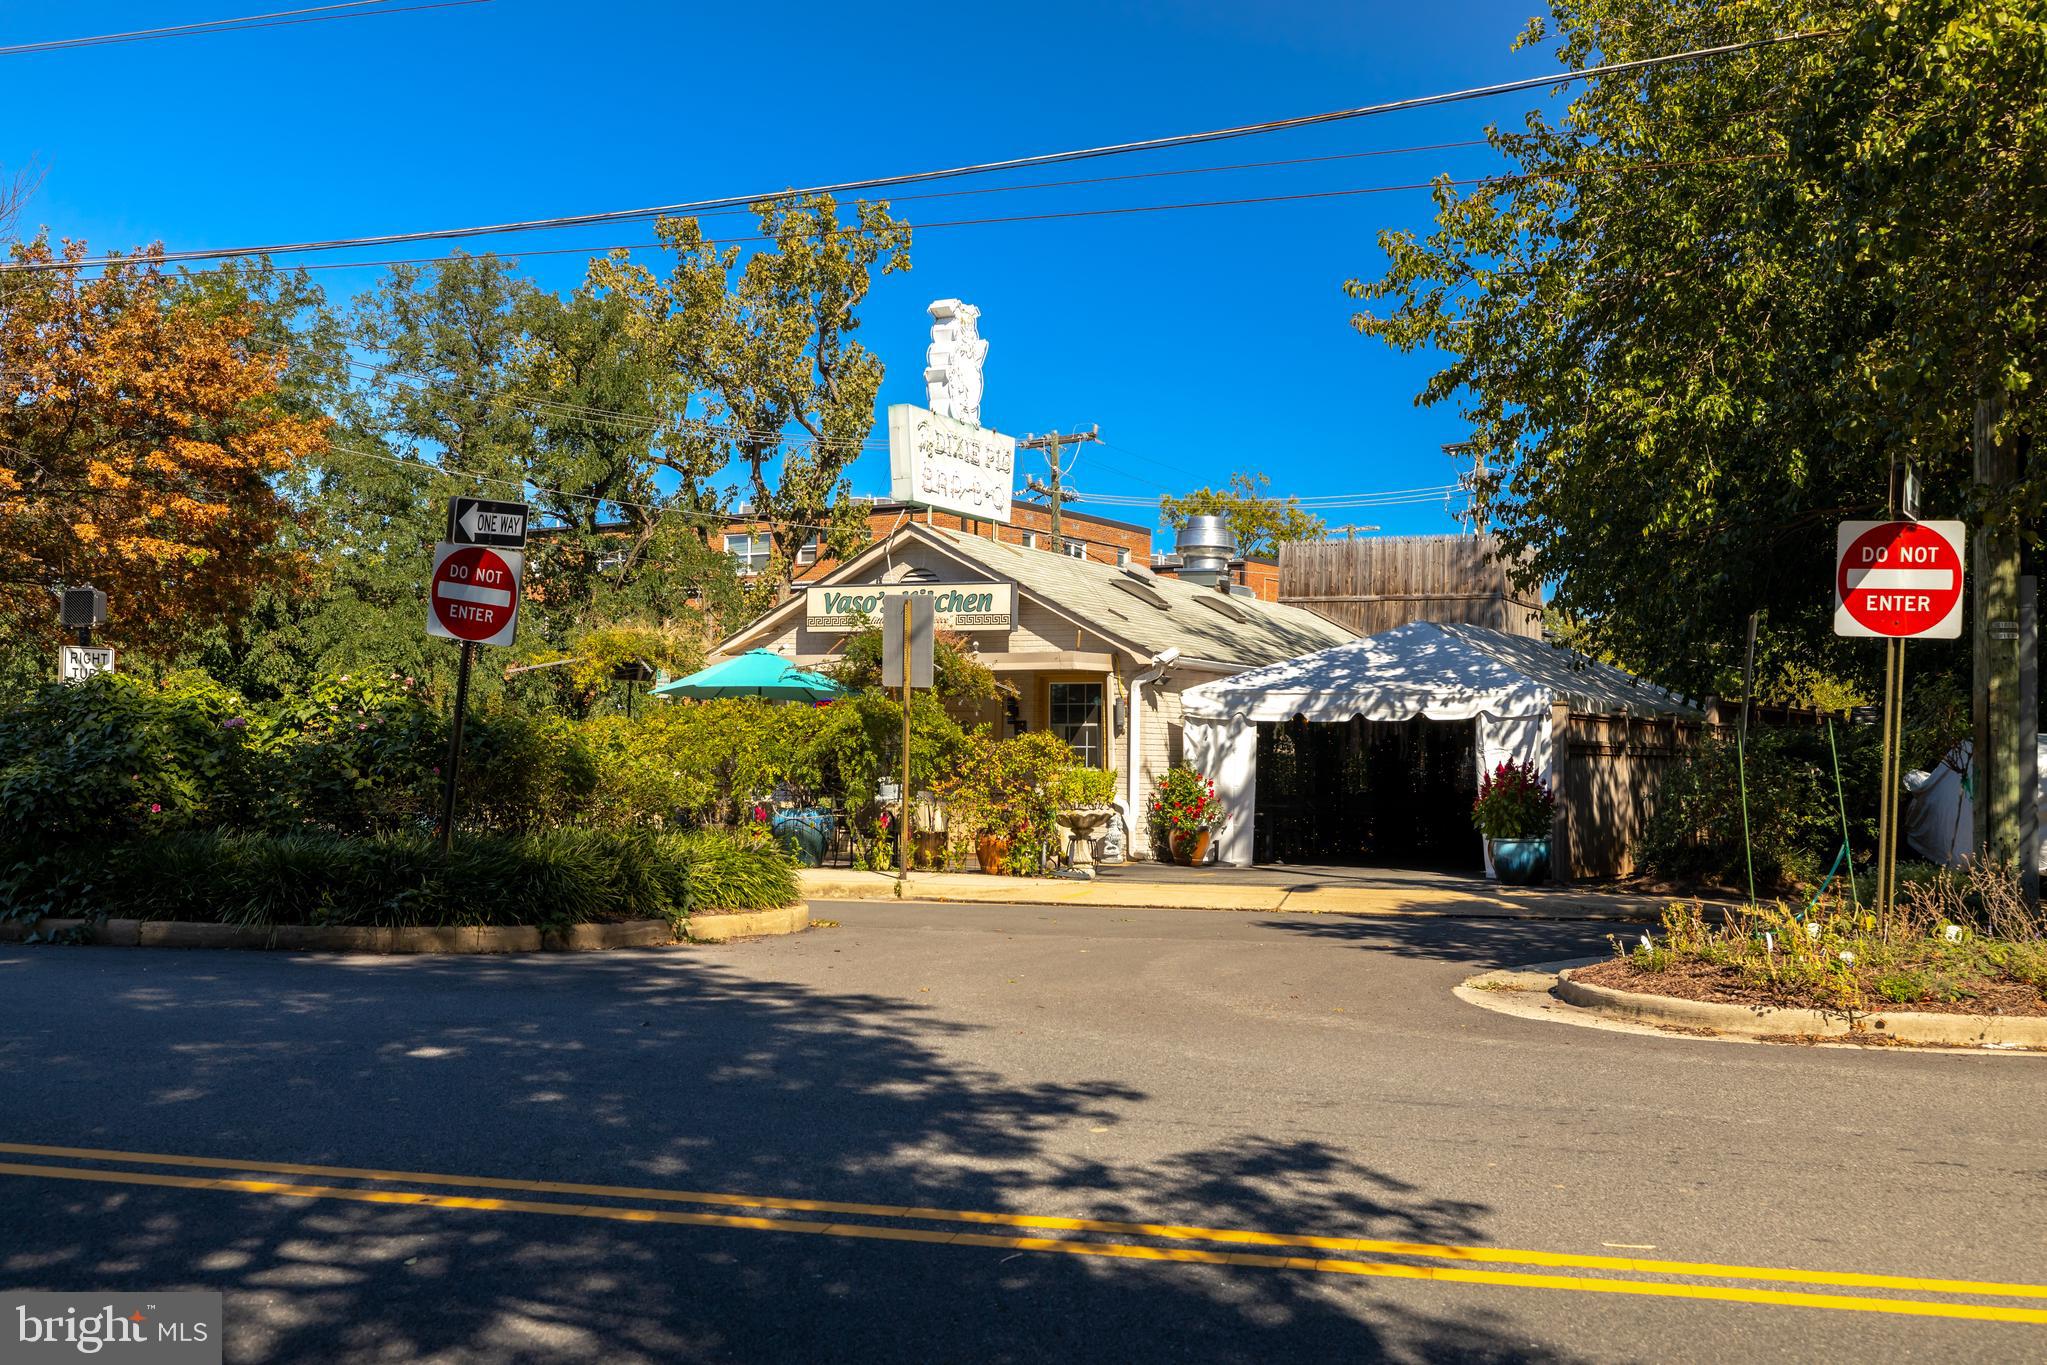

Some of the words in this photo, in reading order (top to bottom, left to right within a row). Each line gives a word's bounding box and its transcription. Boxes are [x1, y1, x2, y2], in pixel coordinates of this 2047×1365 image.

[477, 514, 497, 531] ONE
[500, 515, 521, 534] WAY
[1862, 547, 1888, 562] DO
[1900, 547, 1939, 563] NOT
[450, 564, 468, 579] DO
[475, 568, 503, 584] NOT
[902, 589, 993, 613] chen
[1866, 595, 1930, 612] ENTER
[450, 604, 493, 623] ENTER
[70, 652, 108, 664] RIGHT
[71, 667, 97, 680] TUR
